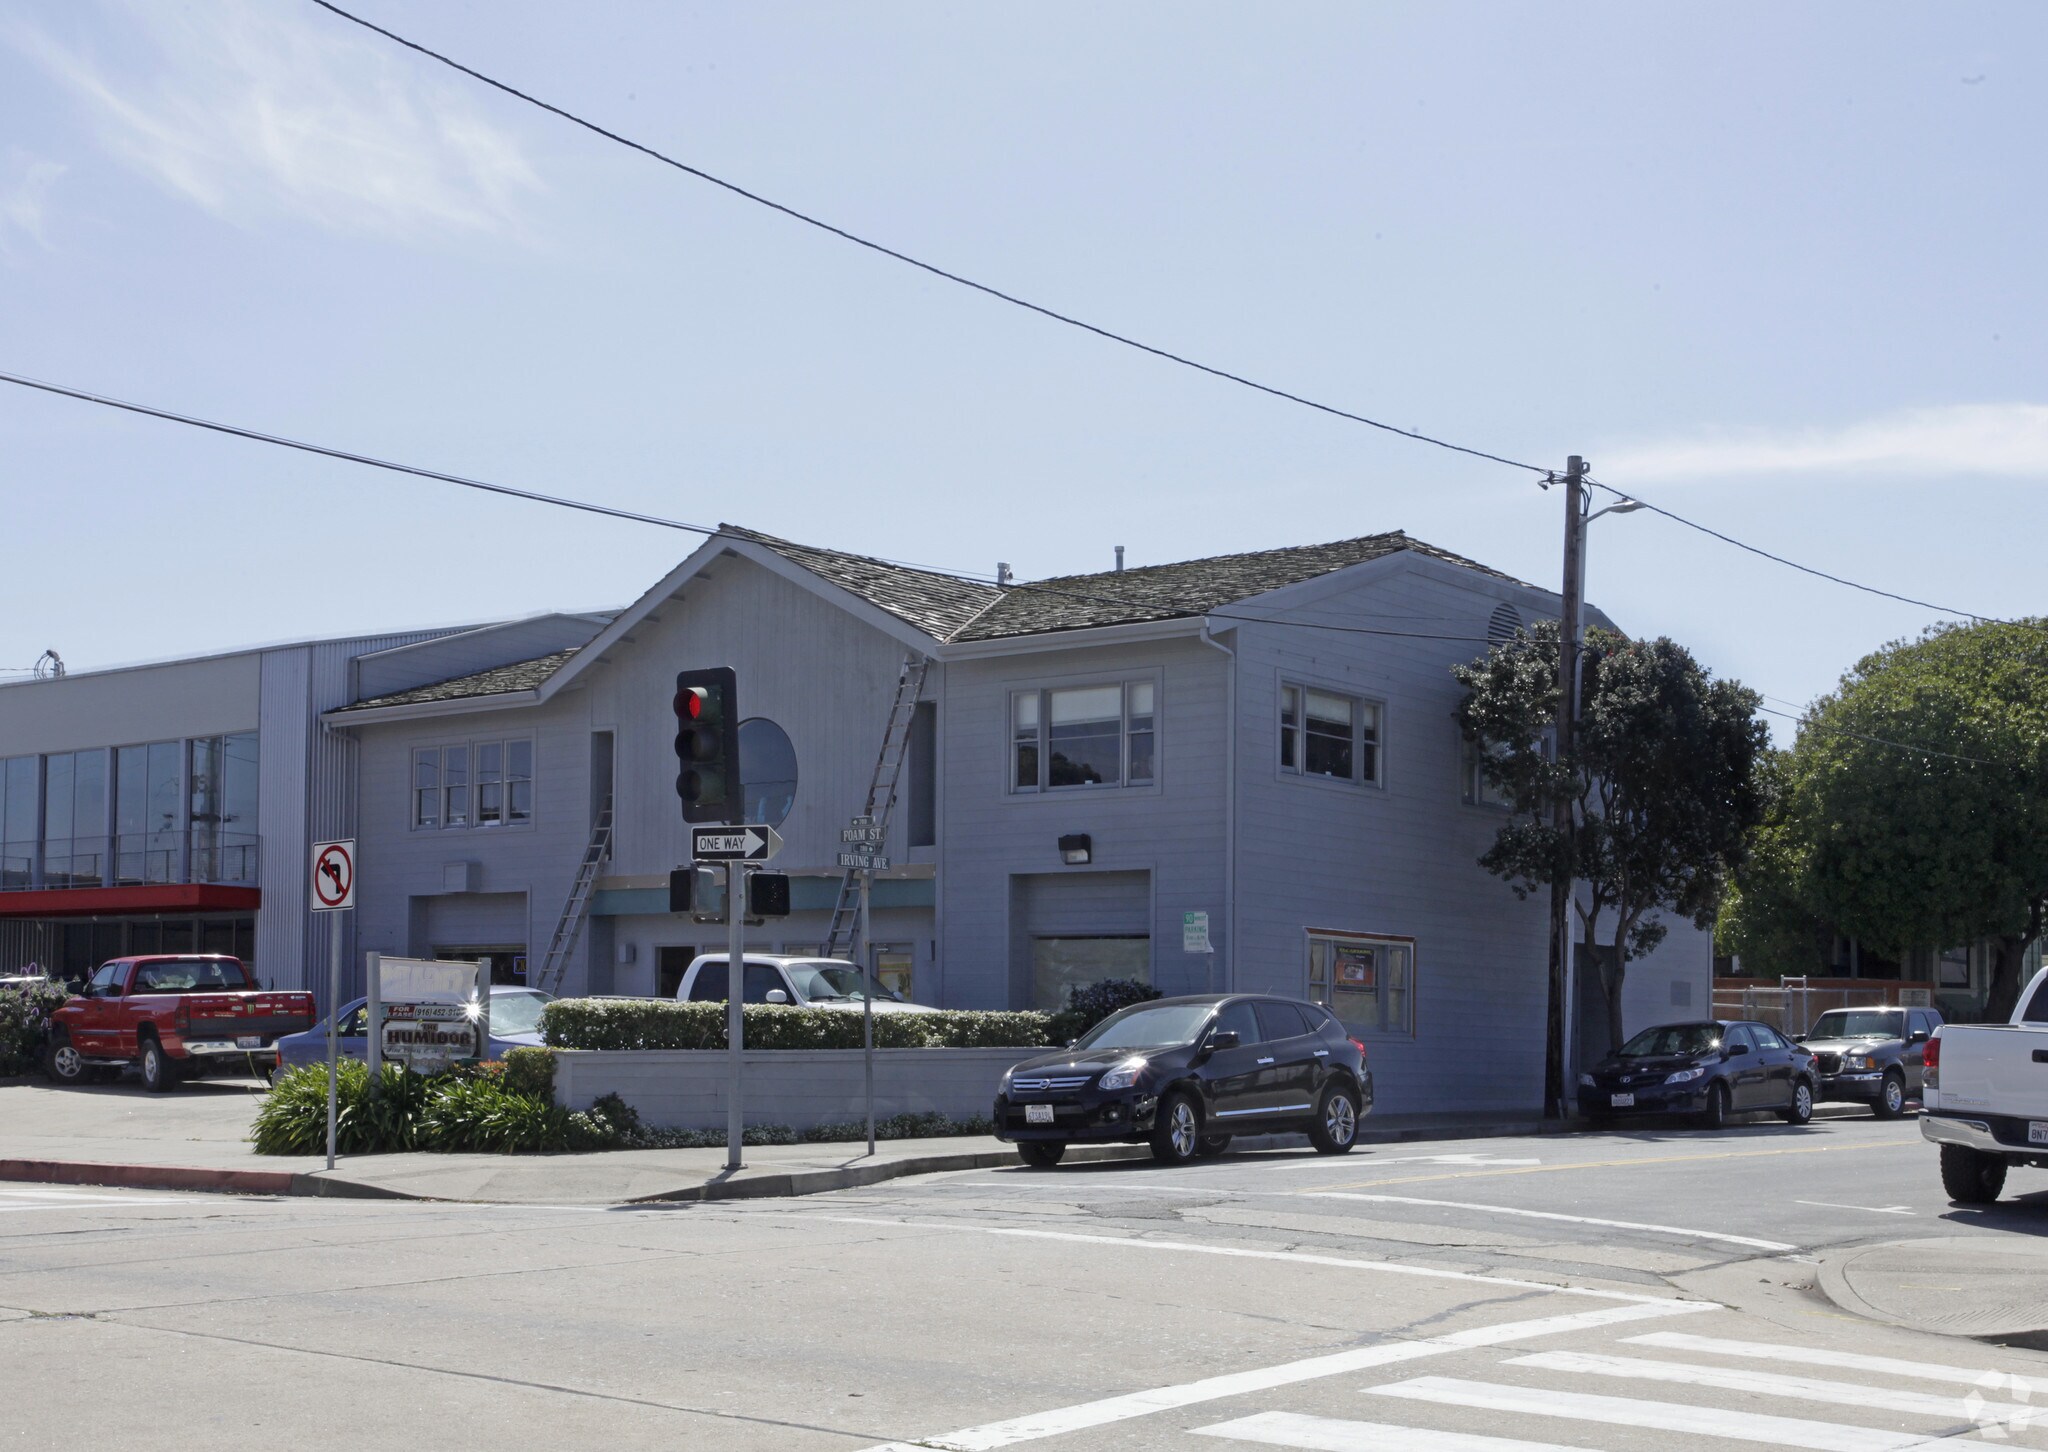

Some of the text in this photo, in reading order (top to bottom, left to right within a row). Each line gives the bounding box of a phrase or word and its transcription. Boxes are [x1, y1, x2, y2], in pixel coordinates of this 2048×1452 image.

[843, 828, 884, 841] FOAM ST.
[700, 837, 746, 850] ONE WAY
[841, 854, 889, 870] IRVING AVE.
[1185, 913, 1193, 923] 90
[387, 1031, 472, 1045] HUMIDOR
